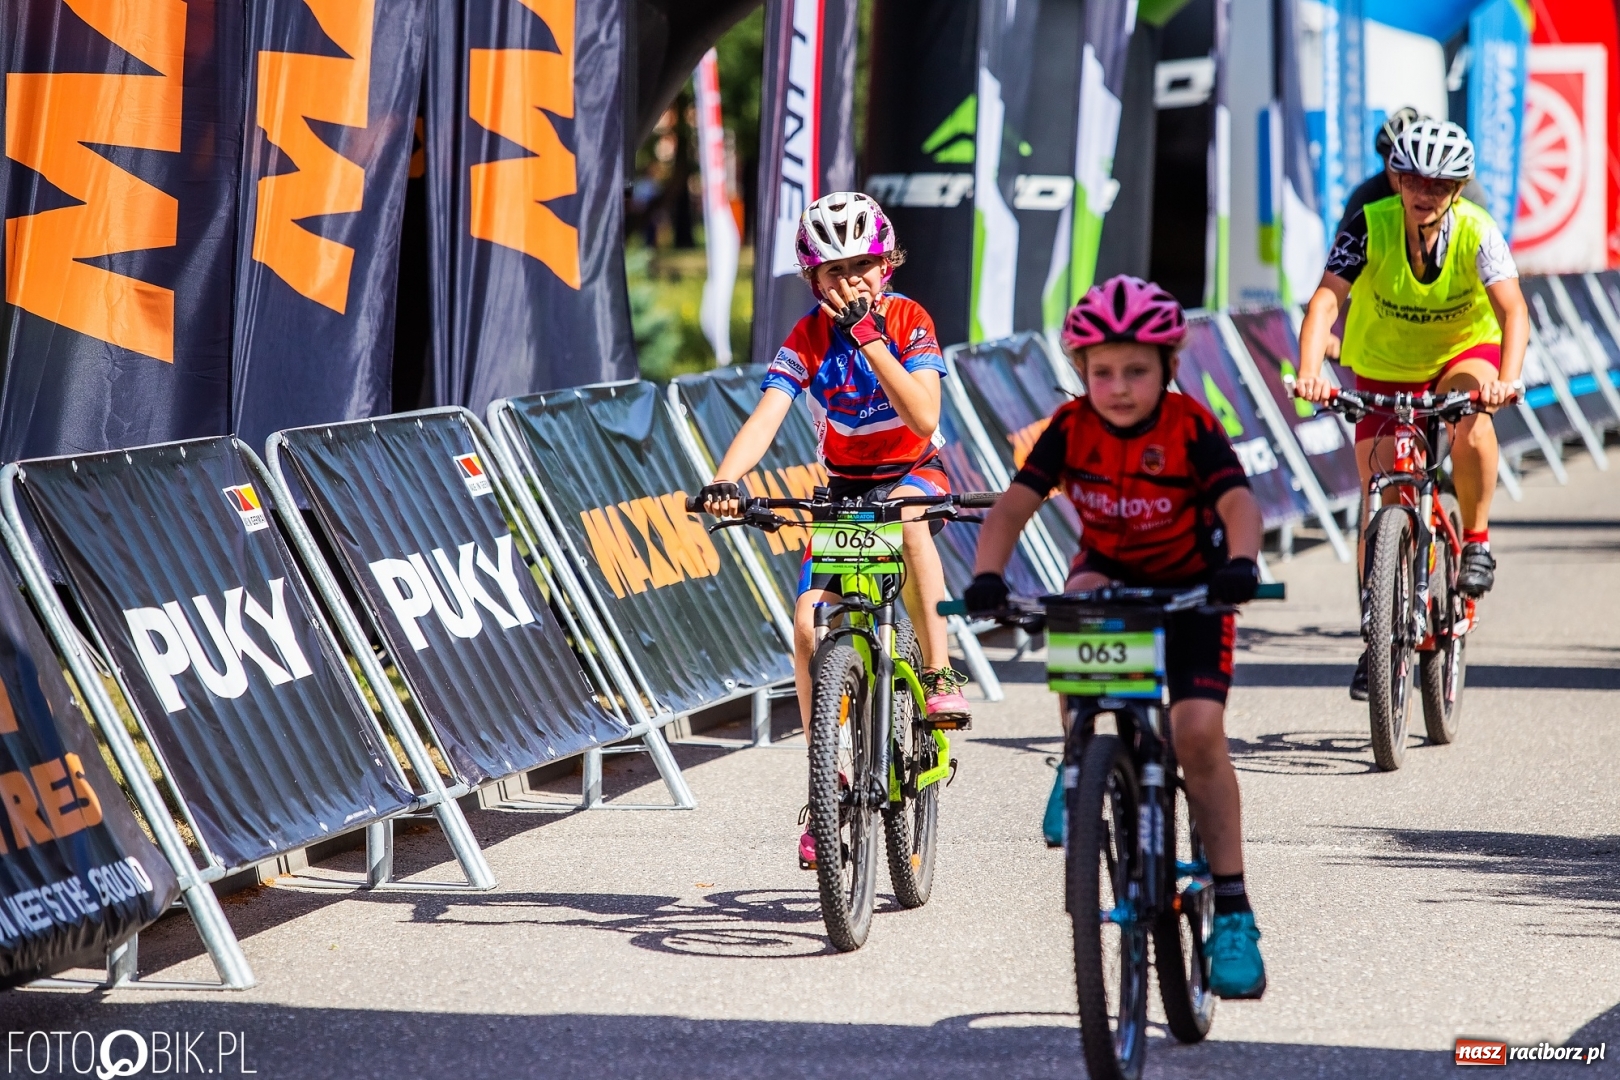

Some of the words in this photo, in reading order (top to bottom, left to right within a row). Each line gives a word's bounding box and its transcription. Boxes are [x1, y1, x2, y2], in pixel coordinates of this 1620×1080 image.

[123, 577, 314, 713] PUKY
[369, 534, 536, 651] PUKY
[1078, 642, 1127, 664] 063
